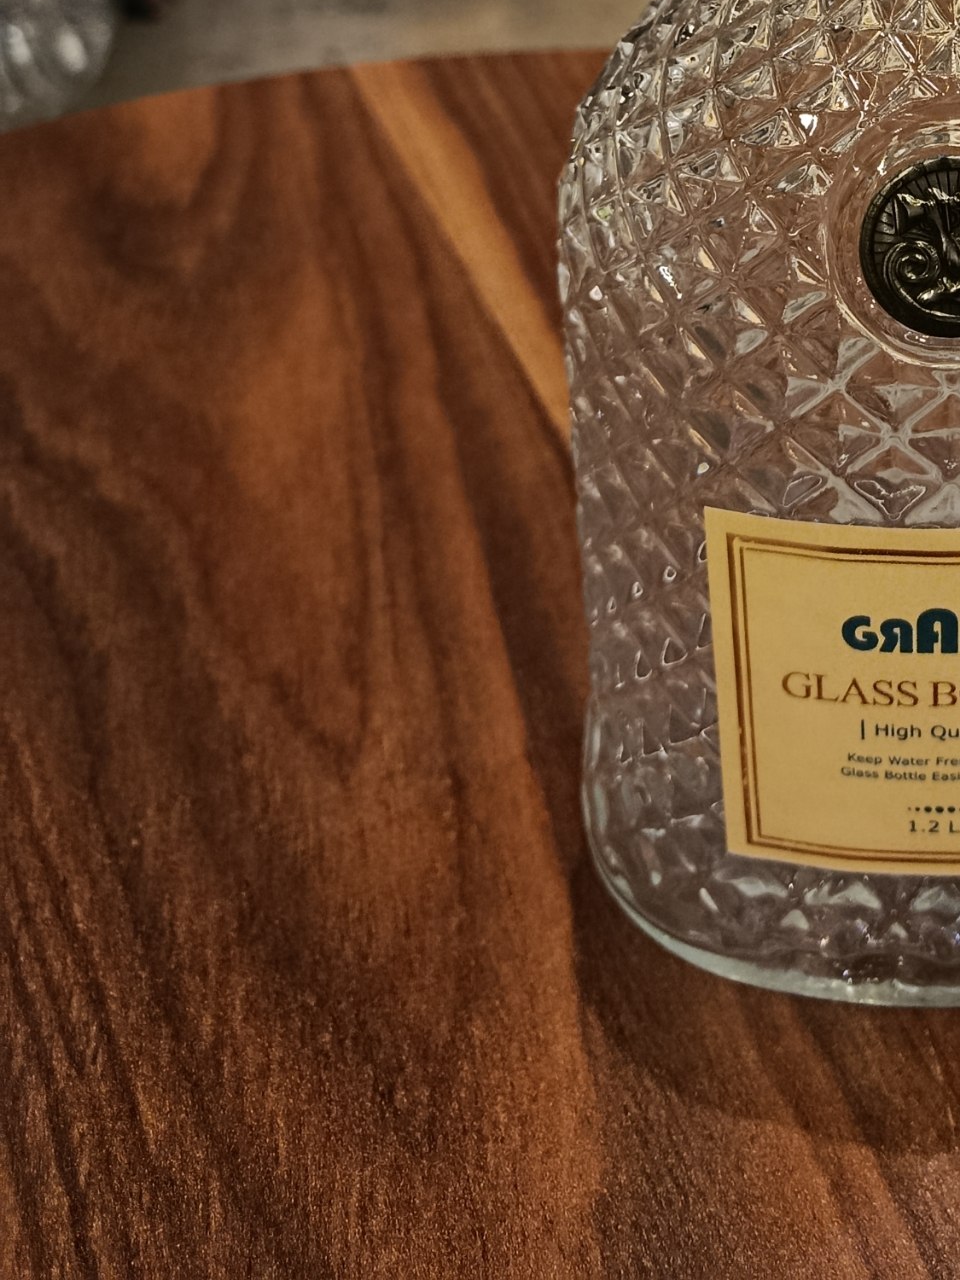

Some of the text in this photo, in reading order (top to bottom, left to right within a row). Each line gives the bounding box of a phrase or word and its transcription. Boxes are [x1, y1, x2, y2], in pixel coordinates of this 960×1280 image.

[781, 671, 920, 708] GLASS
[874, 723, 922, 741] High
[847, 752, 883, 766] Keep
[888, 755, 930, 767] Water
[840, 766, 880, 780] Glass
[884, 769, 927, 782] Bottle
[909, 819, 940, 834] 1.2
